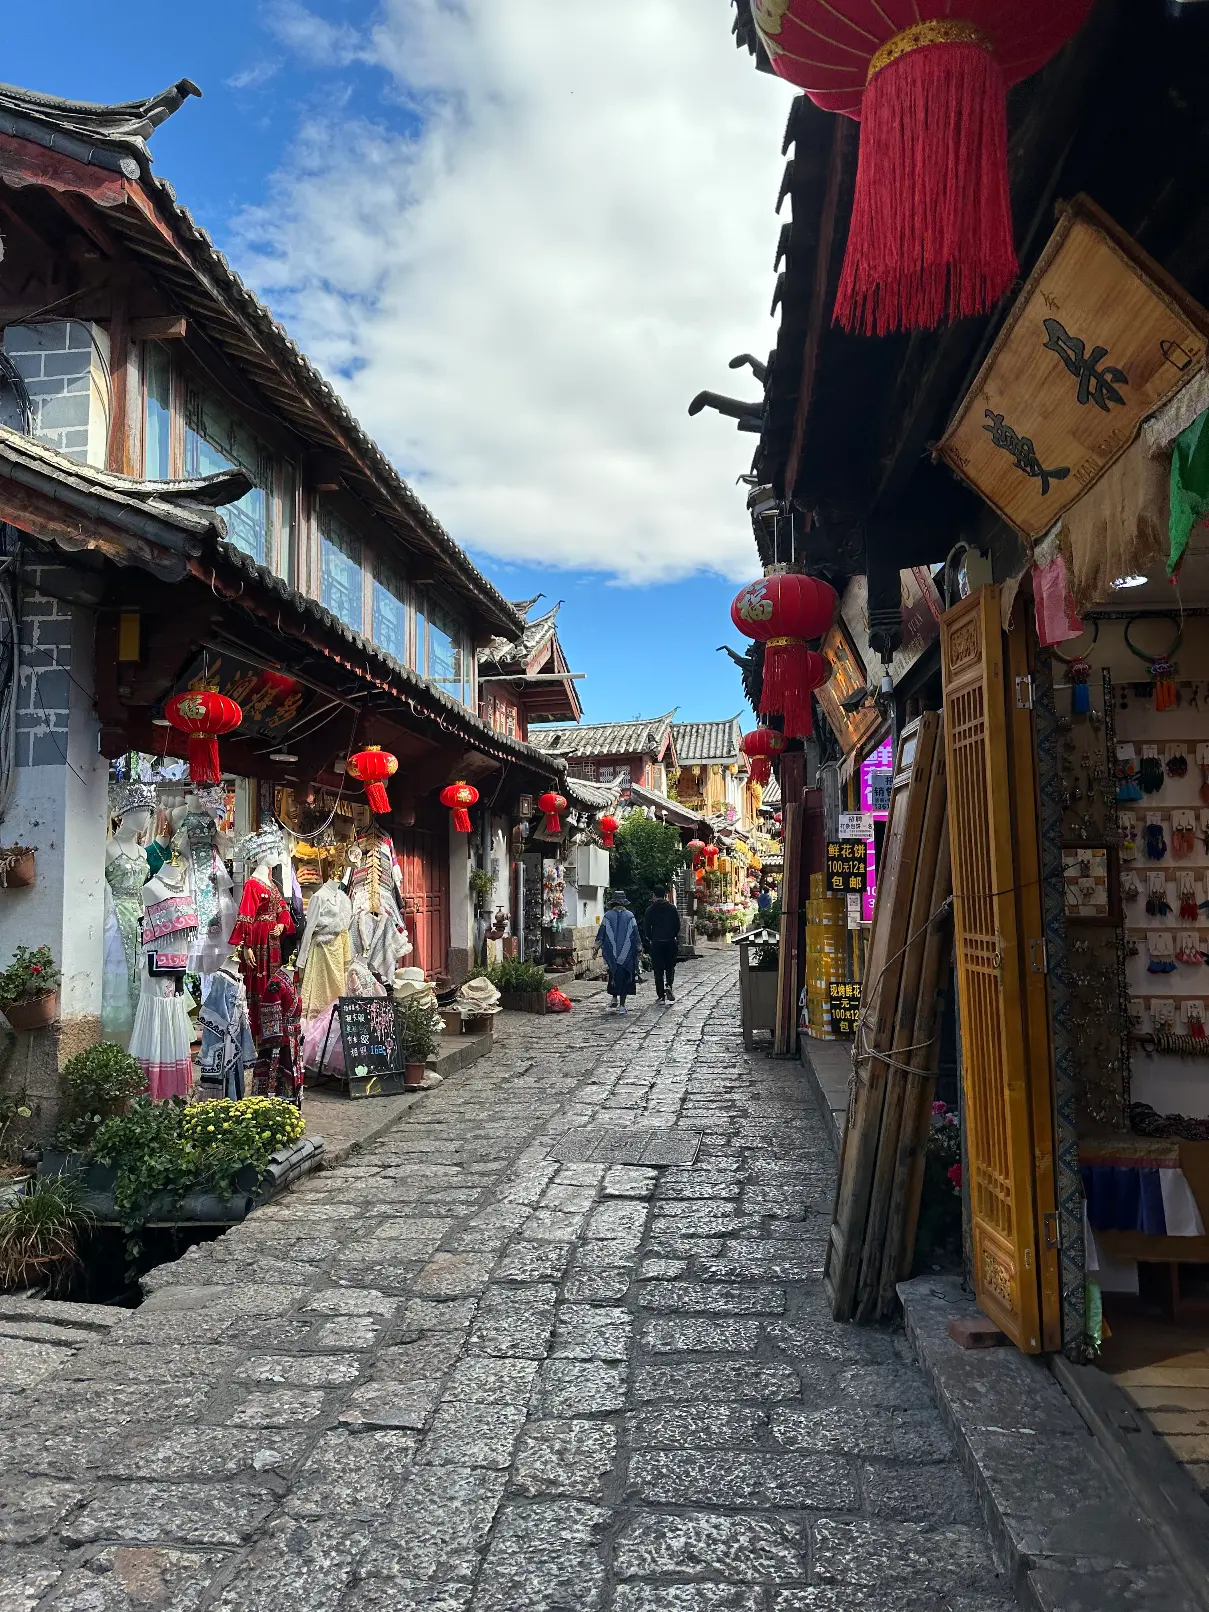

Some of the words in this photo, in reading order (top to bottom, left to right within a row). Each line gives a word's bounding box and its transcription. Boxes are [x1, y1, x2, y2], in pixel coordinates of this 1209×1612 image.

[828, 844, 866, 858] 鲜花饼
[828, 860, 866, 873] 100元12盒
[831, 876, 862, 889] 包邮
[830, 984, 863, 997] 现烤鲜花
